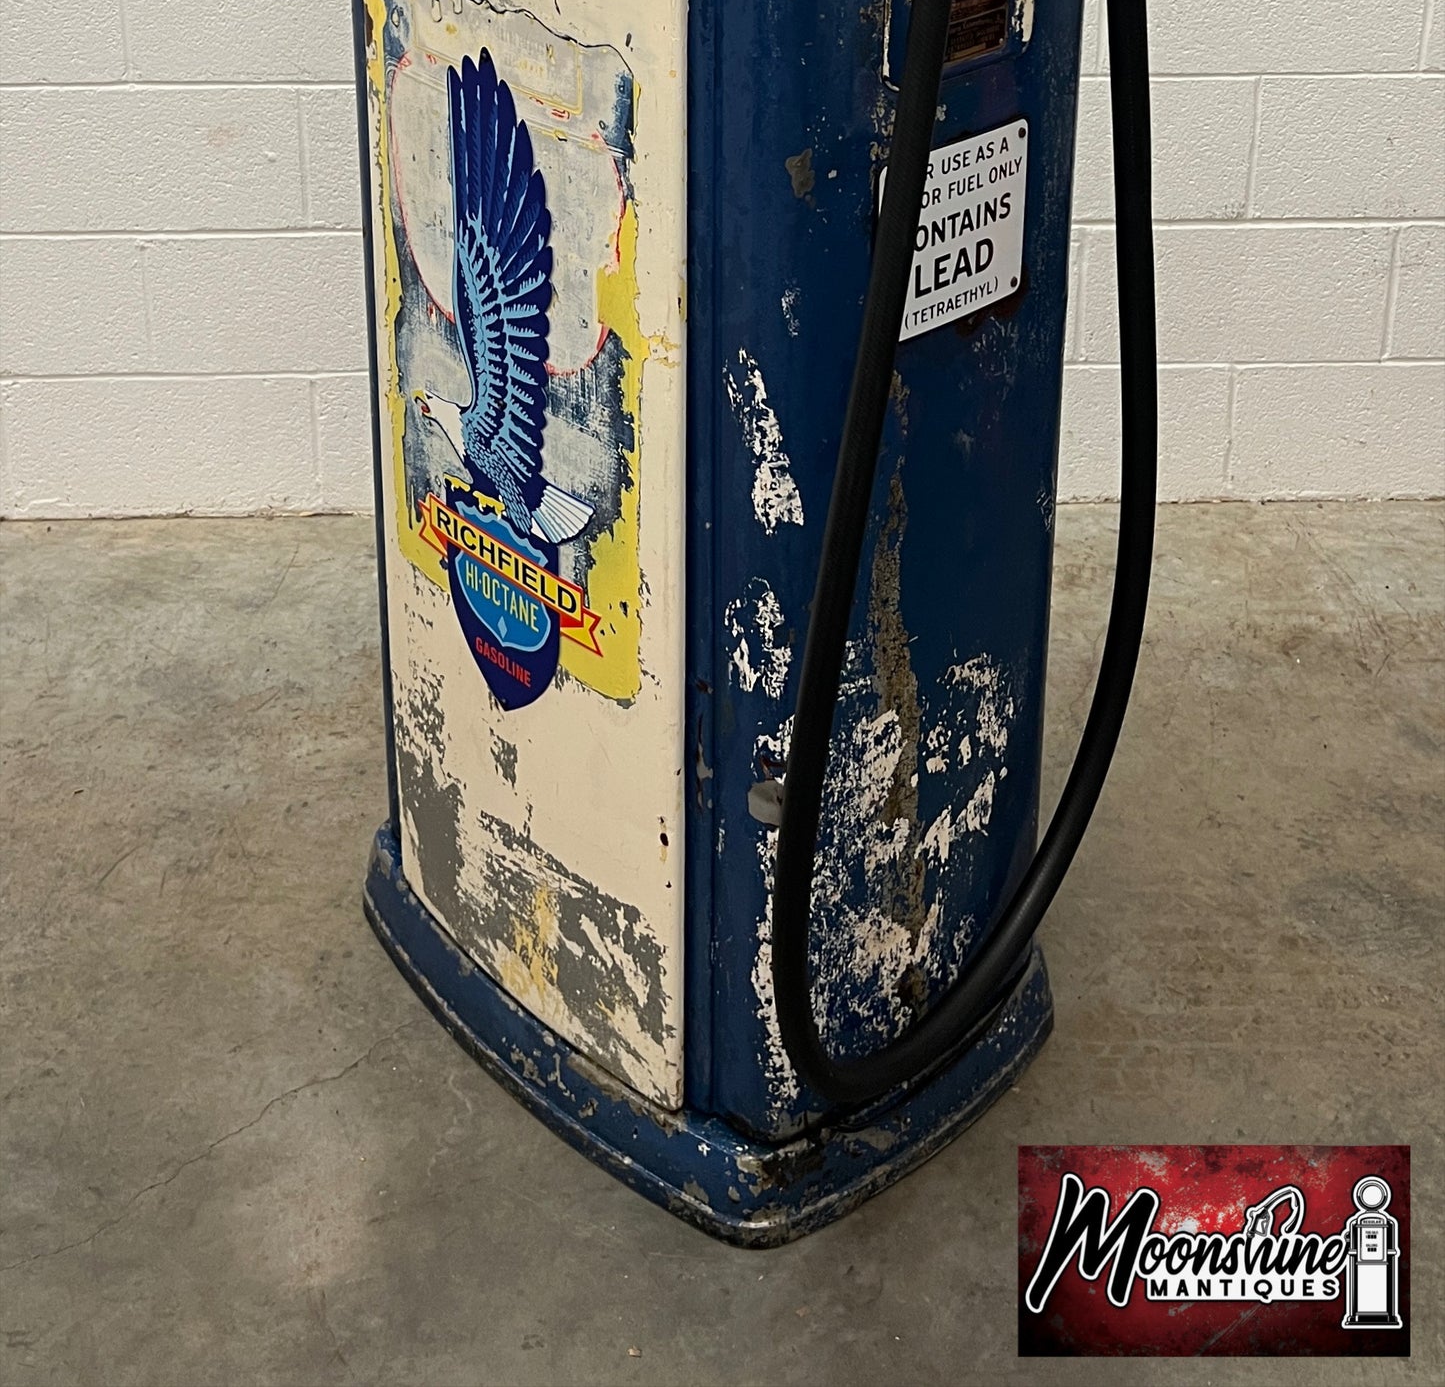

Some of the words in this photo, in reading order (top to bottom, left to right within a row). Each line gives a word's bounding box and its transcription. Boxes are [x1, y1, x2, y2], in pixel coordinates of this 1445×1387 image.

[941, 150, 971, 175] USE
[976, 141, 995, 164] AS
[1000, 136, 1009, 154] A
[948, 173, 984, 200] FUEL
[989, 156, 1022, 184] ONLY
[914, 192, 1012, 252] ONTAINS
[914, 238, 994, 300] LEAD
[436, 506, 577, 614] RICHFIELD
[475, 636, 532, 688] GASOLINE
